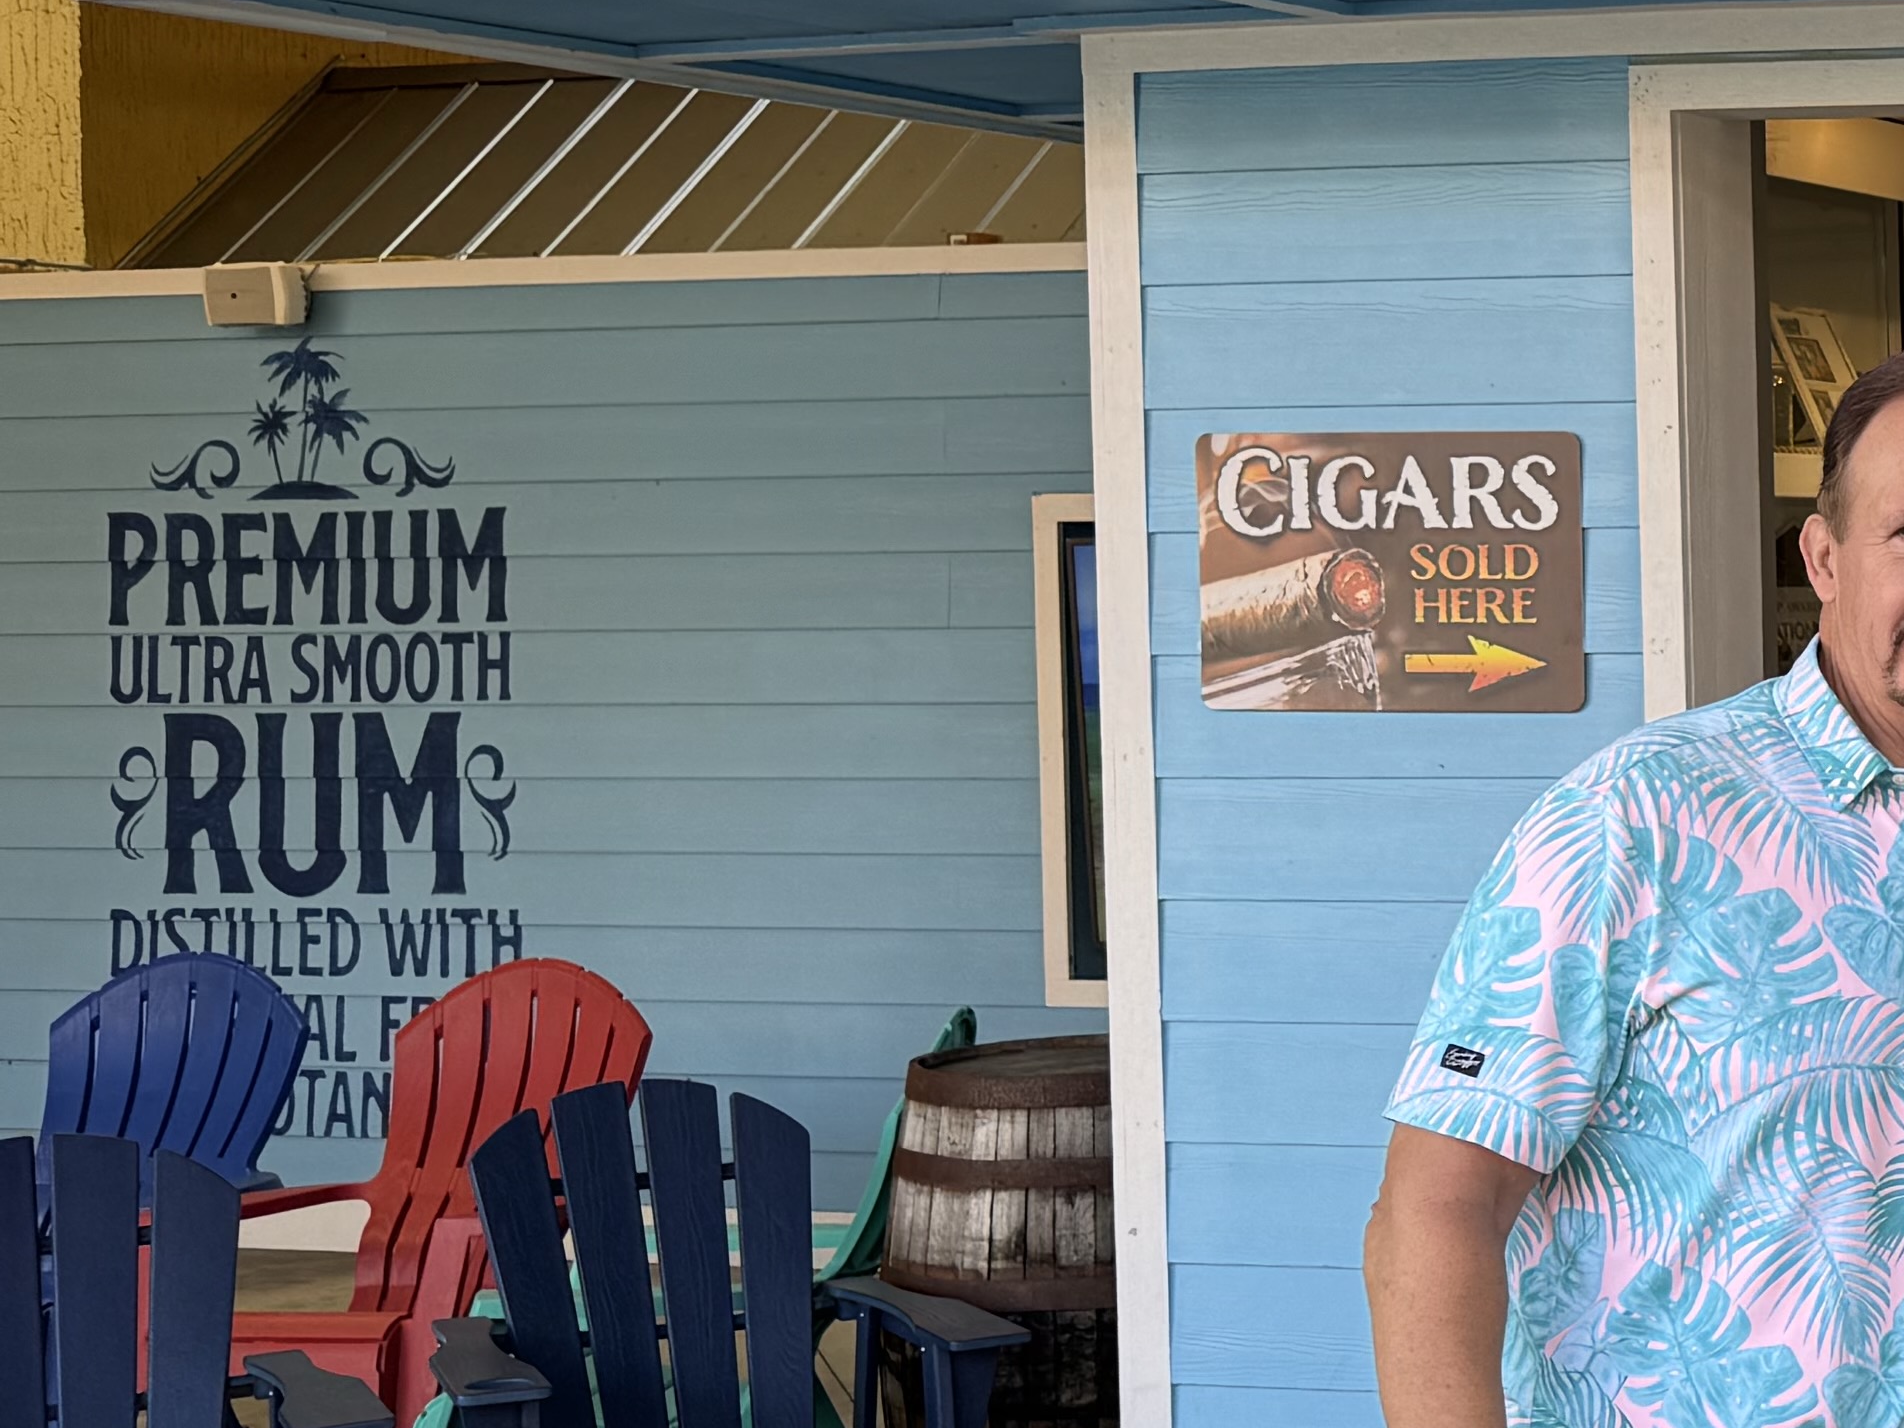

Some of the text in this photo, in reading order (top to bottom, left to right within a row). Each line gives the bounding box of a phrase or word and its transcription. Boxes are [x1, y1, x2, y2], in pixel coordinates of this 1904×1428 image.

[1217, 447, 1560, 538] CIGARS
[106, 506, 510, 627] PREMIUM
[1409, 543, 1540, 581] SOLD
[1413, 587, 1538, 625] HERE
[108, 630, 512, 704] ULTRA SMOOTH
[162, 712, 467, 896] RUM
[109, 907, 524, 977] DISTILLED WITH
